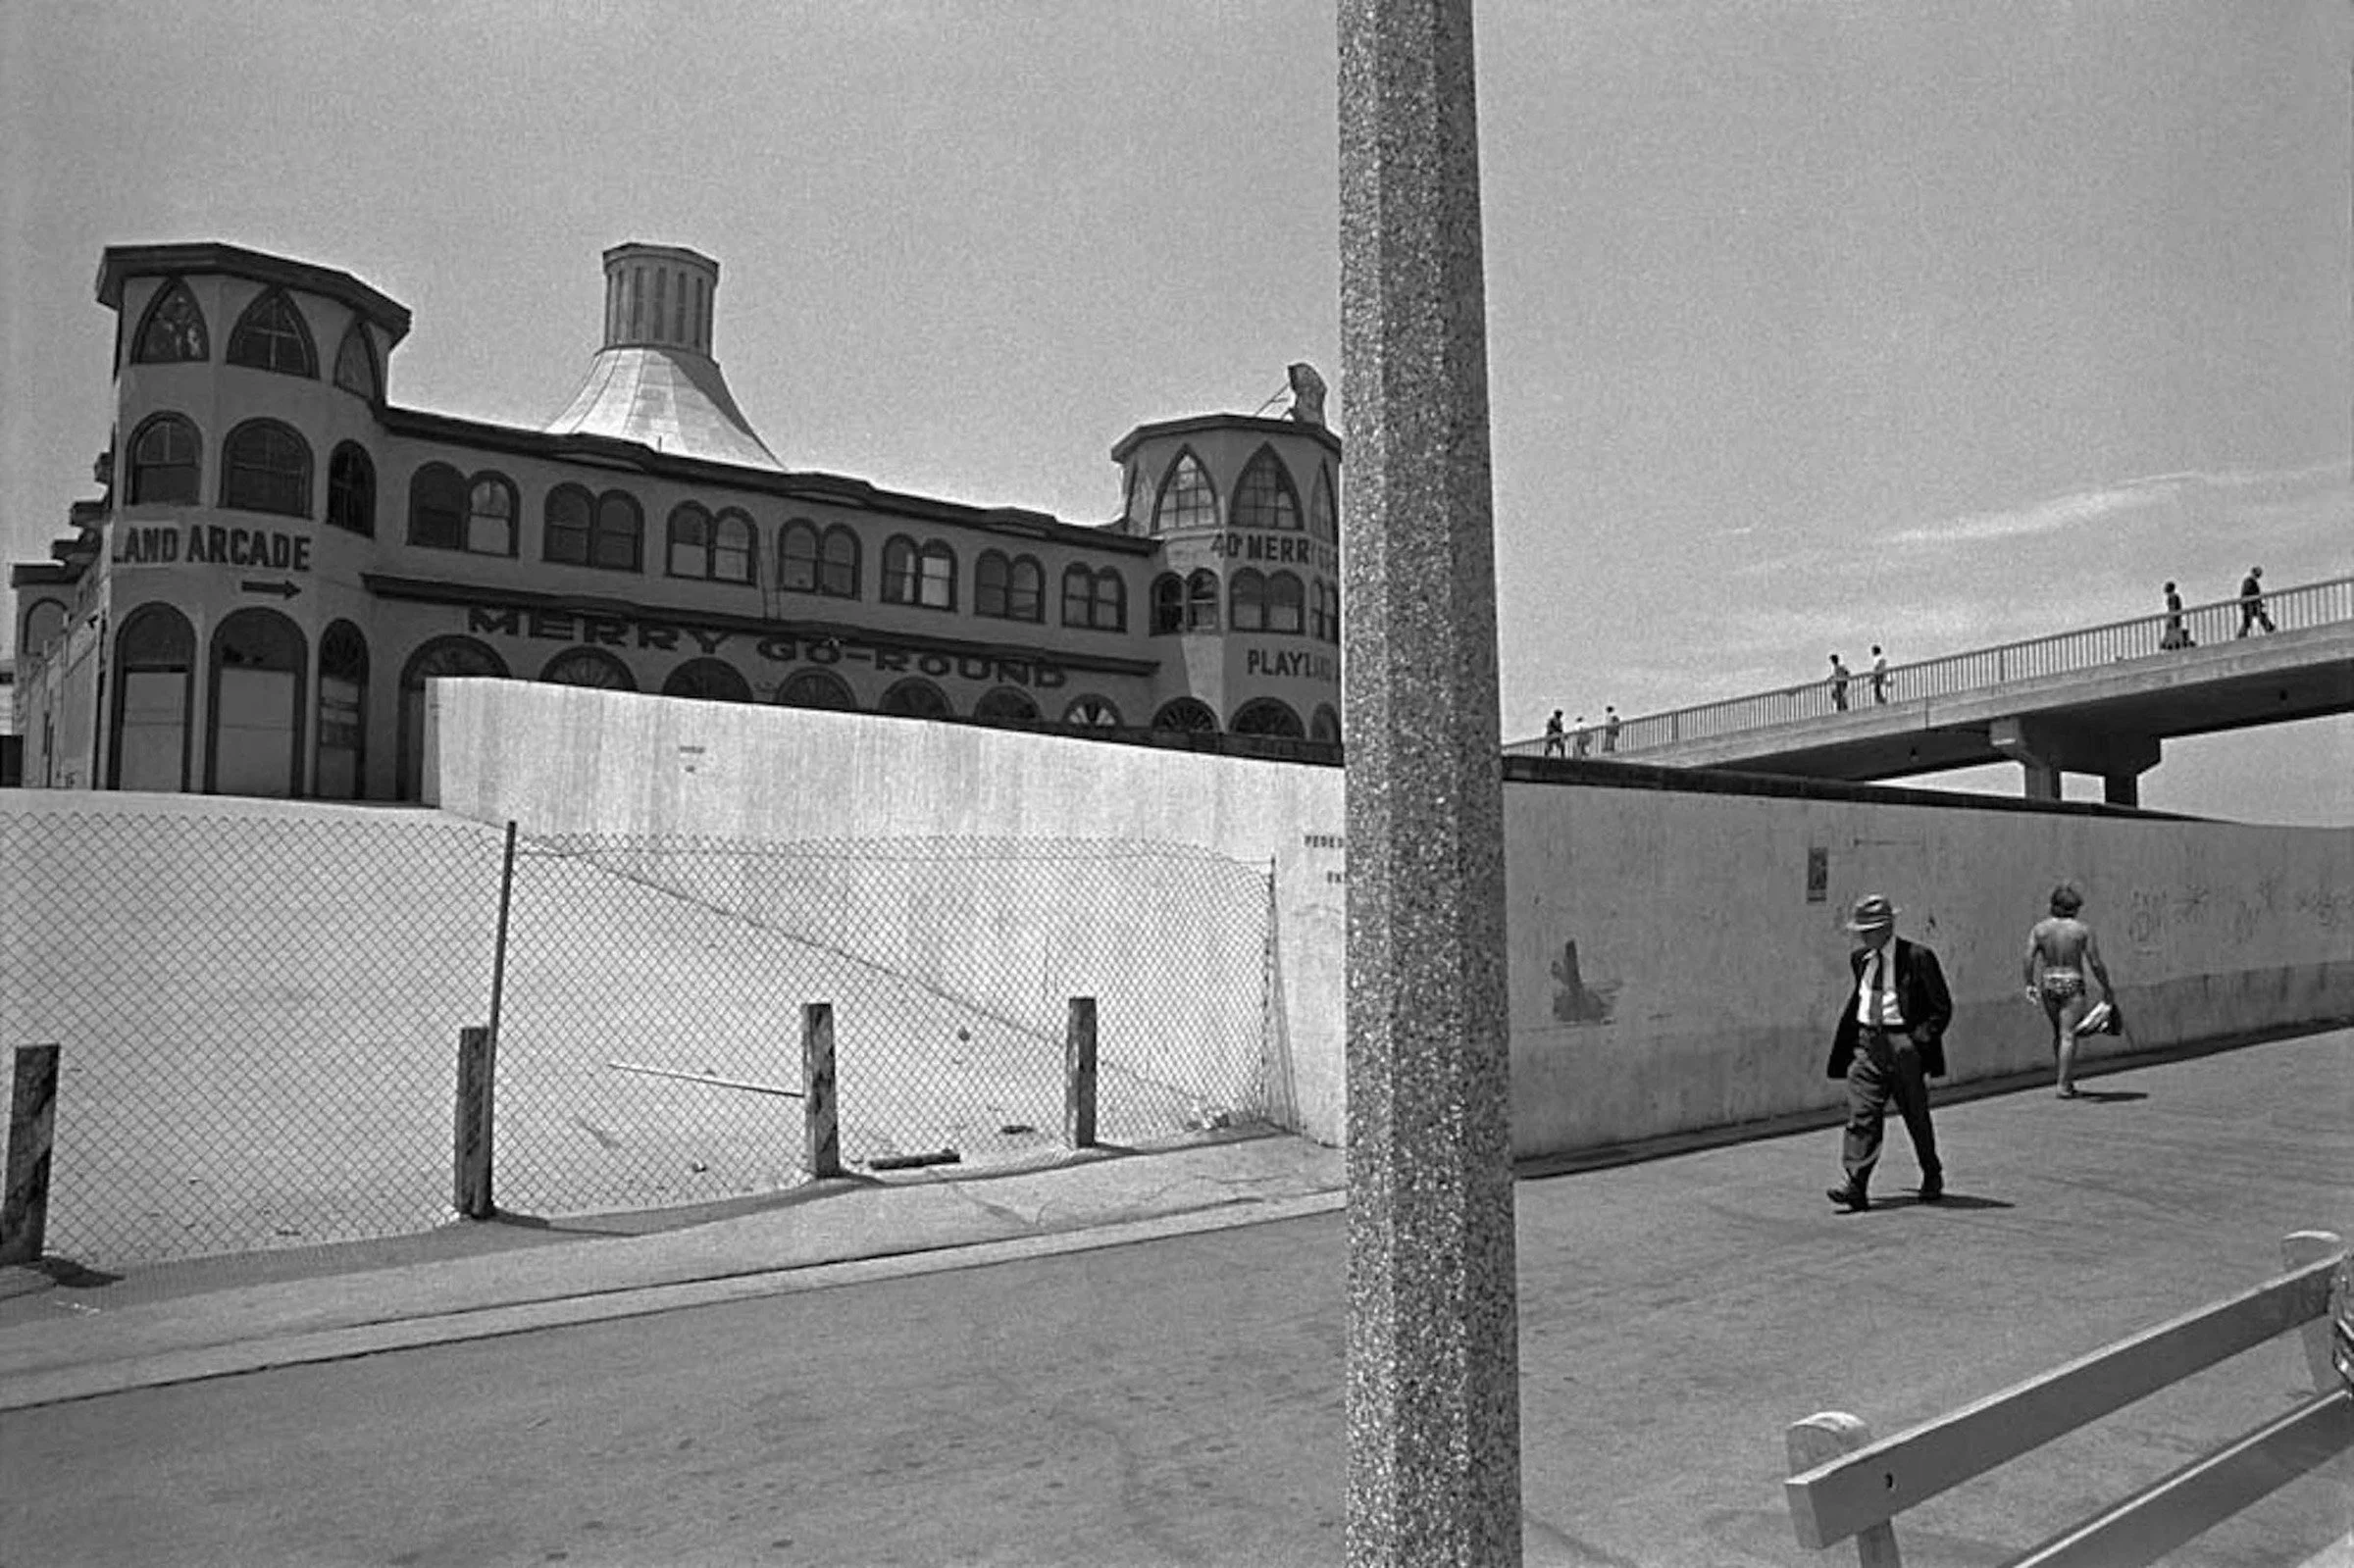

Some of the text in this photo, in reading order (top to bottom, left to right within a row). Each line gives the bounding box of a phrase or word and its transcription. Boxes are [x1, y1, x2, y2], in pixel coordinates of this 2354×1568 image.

[187, 526, 312, 571] ARCADE
[468, 608, 1067, 688] MERRY GO-ROUND
